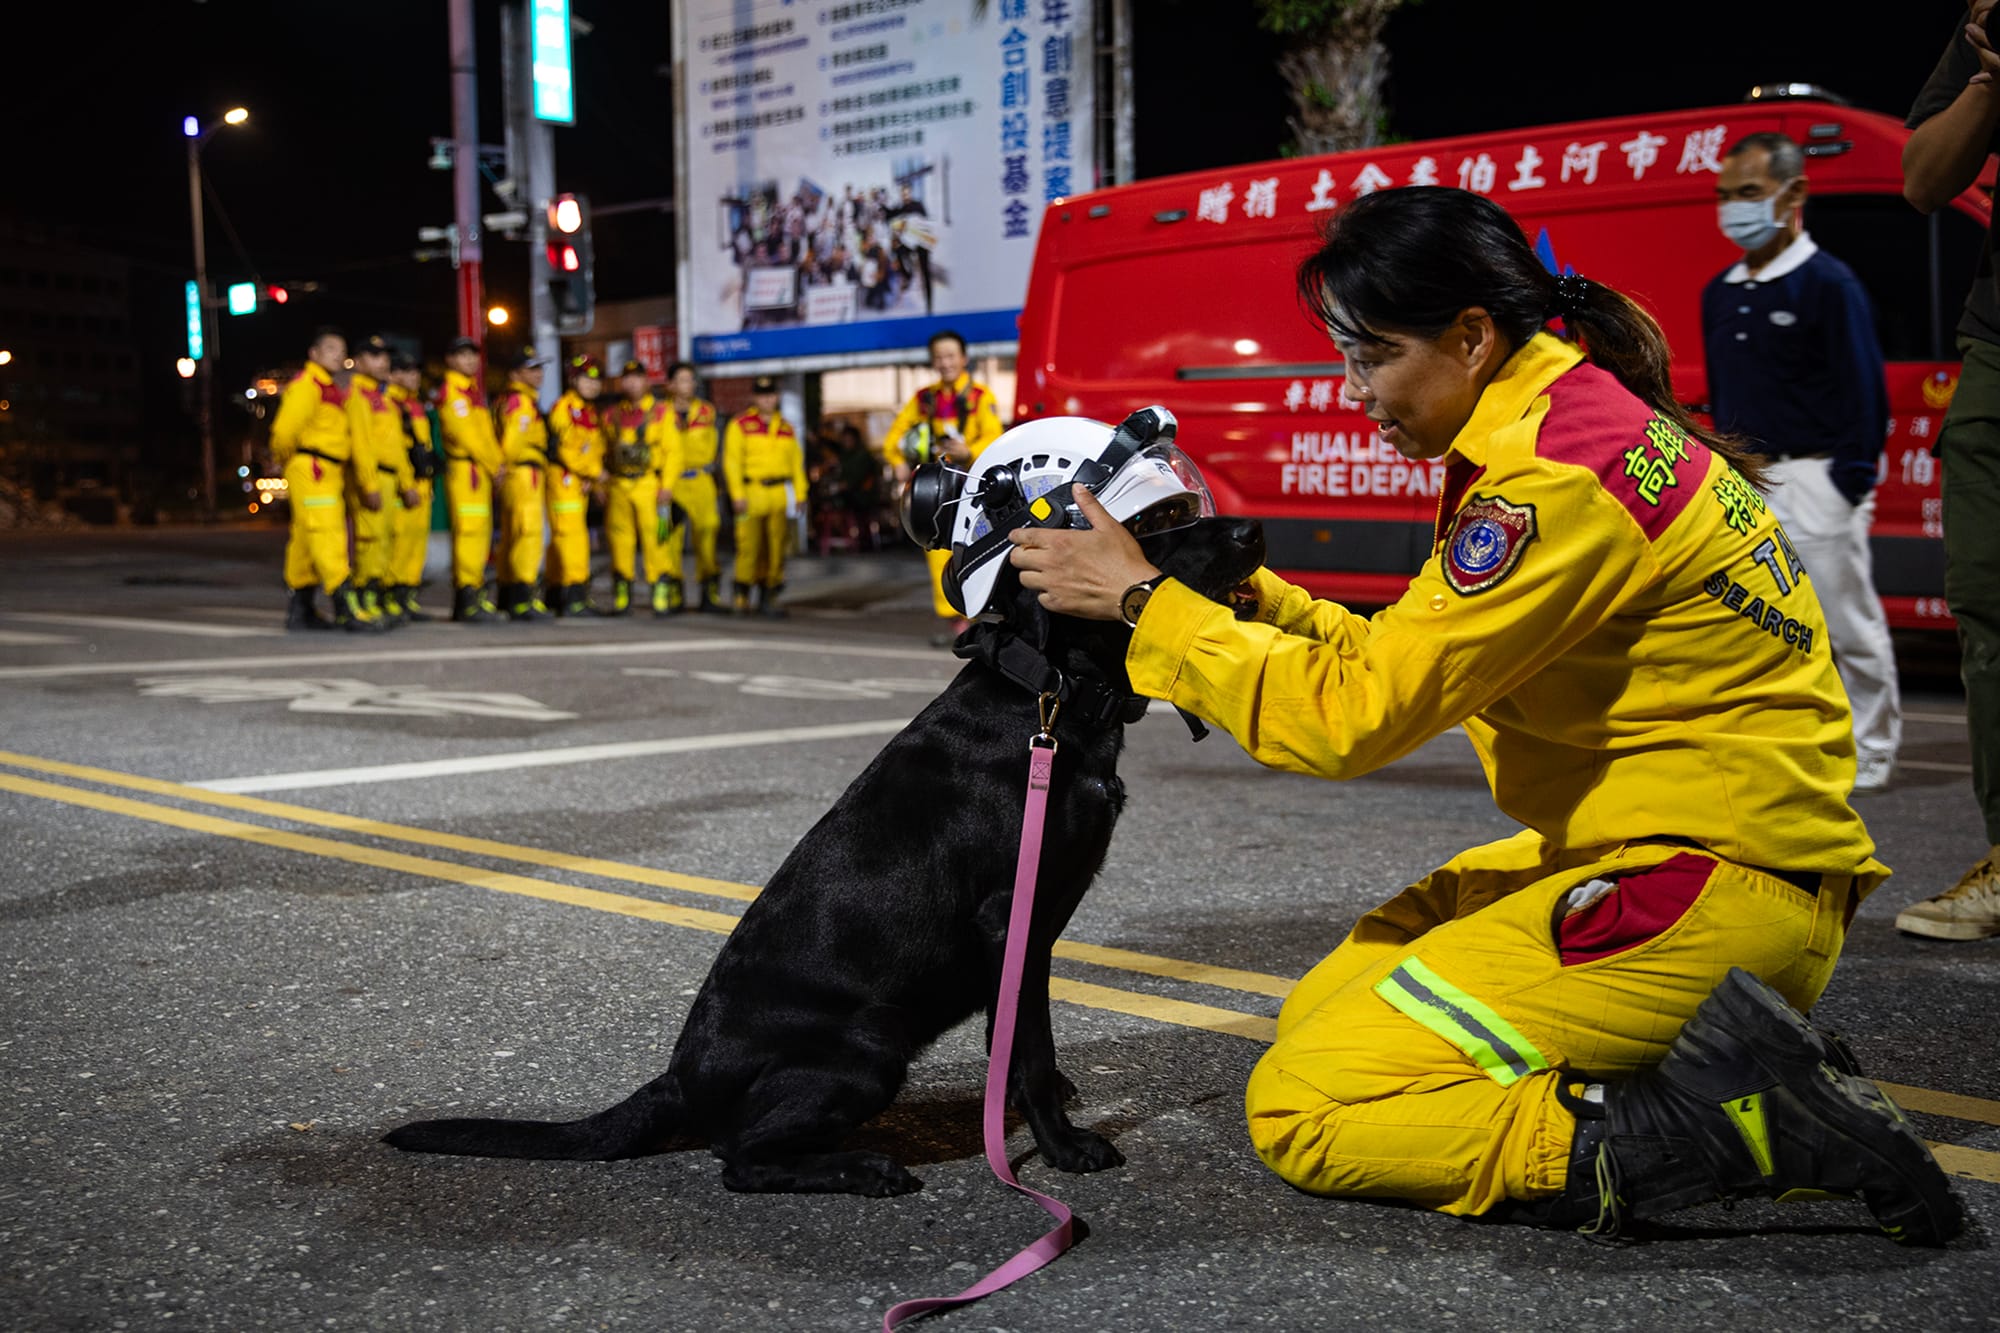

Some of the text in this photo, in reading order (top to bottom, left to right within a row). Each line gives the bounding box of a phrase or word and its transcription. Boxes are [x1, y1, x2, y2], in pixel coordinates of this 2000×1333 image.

[1291, 432, 1418, 463] HUALIE
[1623, 409, 1697, 506] 高雄
[1281, 464, 1349, 496] FIRE
[1703, 569, 1814, 654] SEARCH
